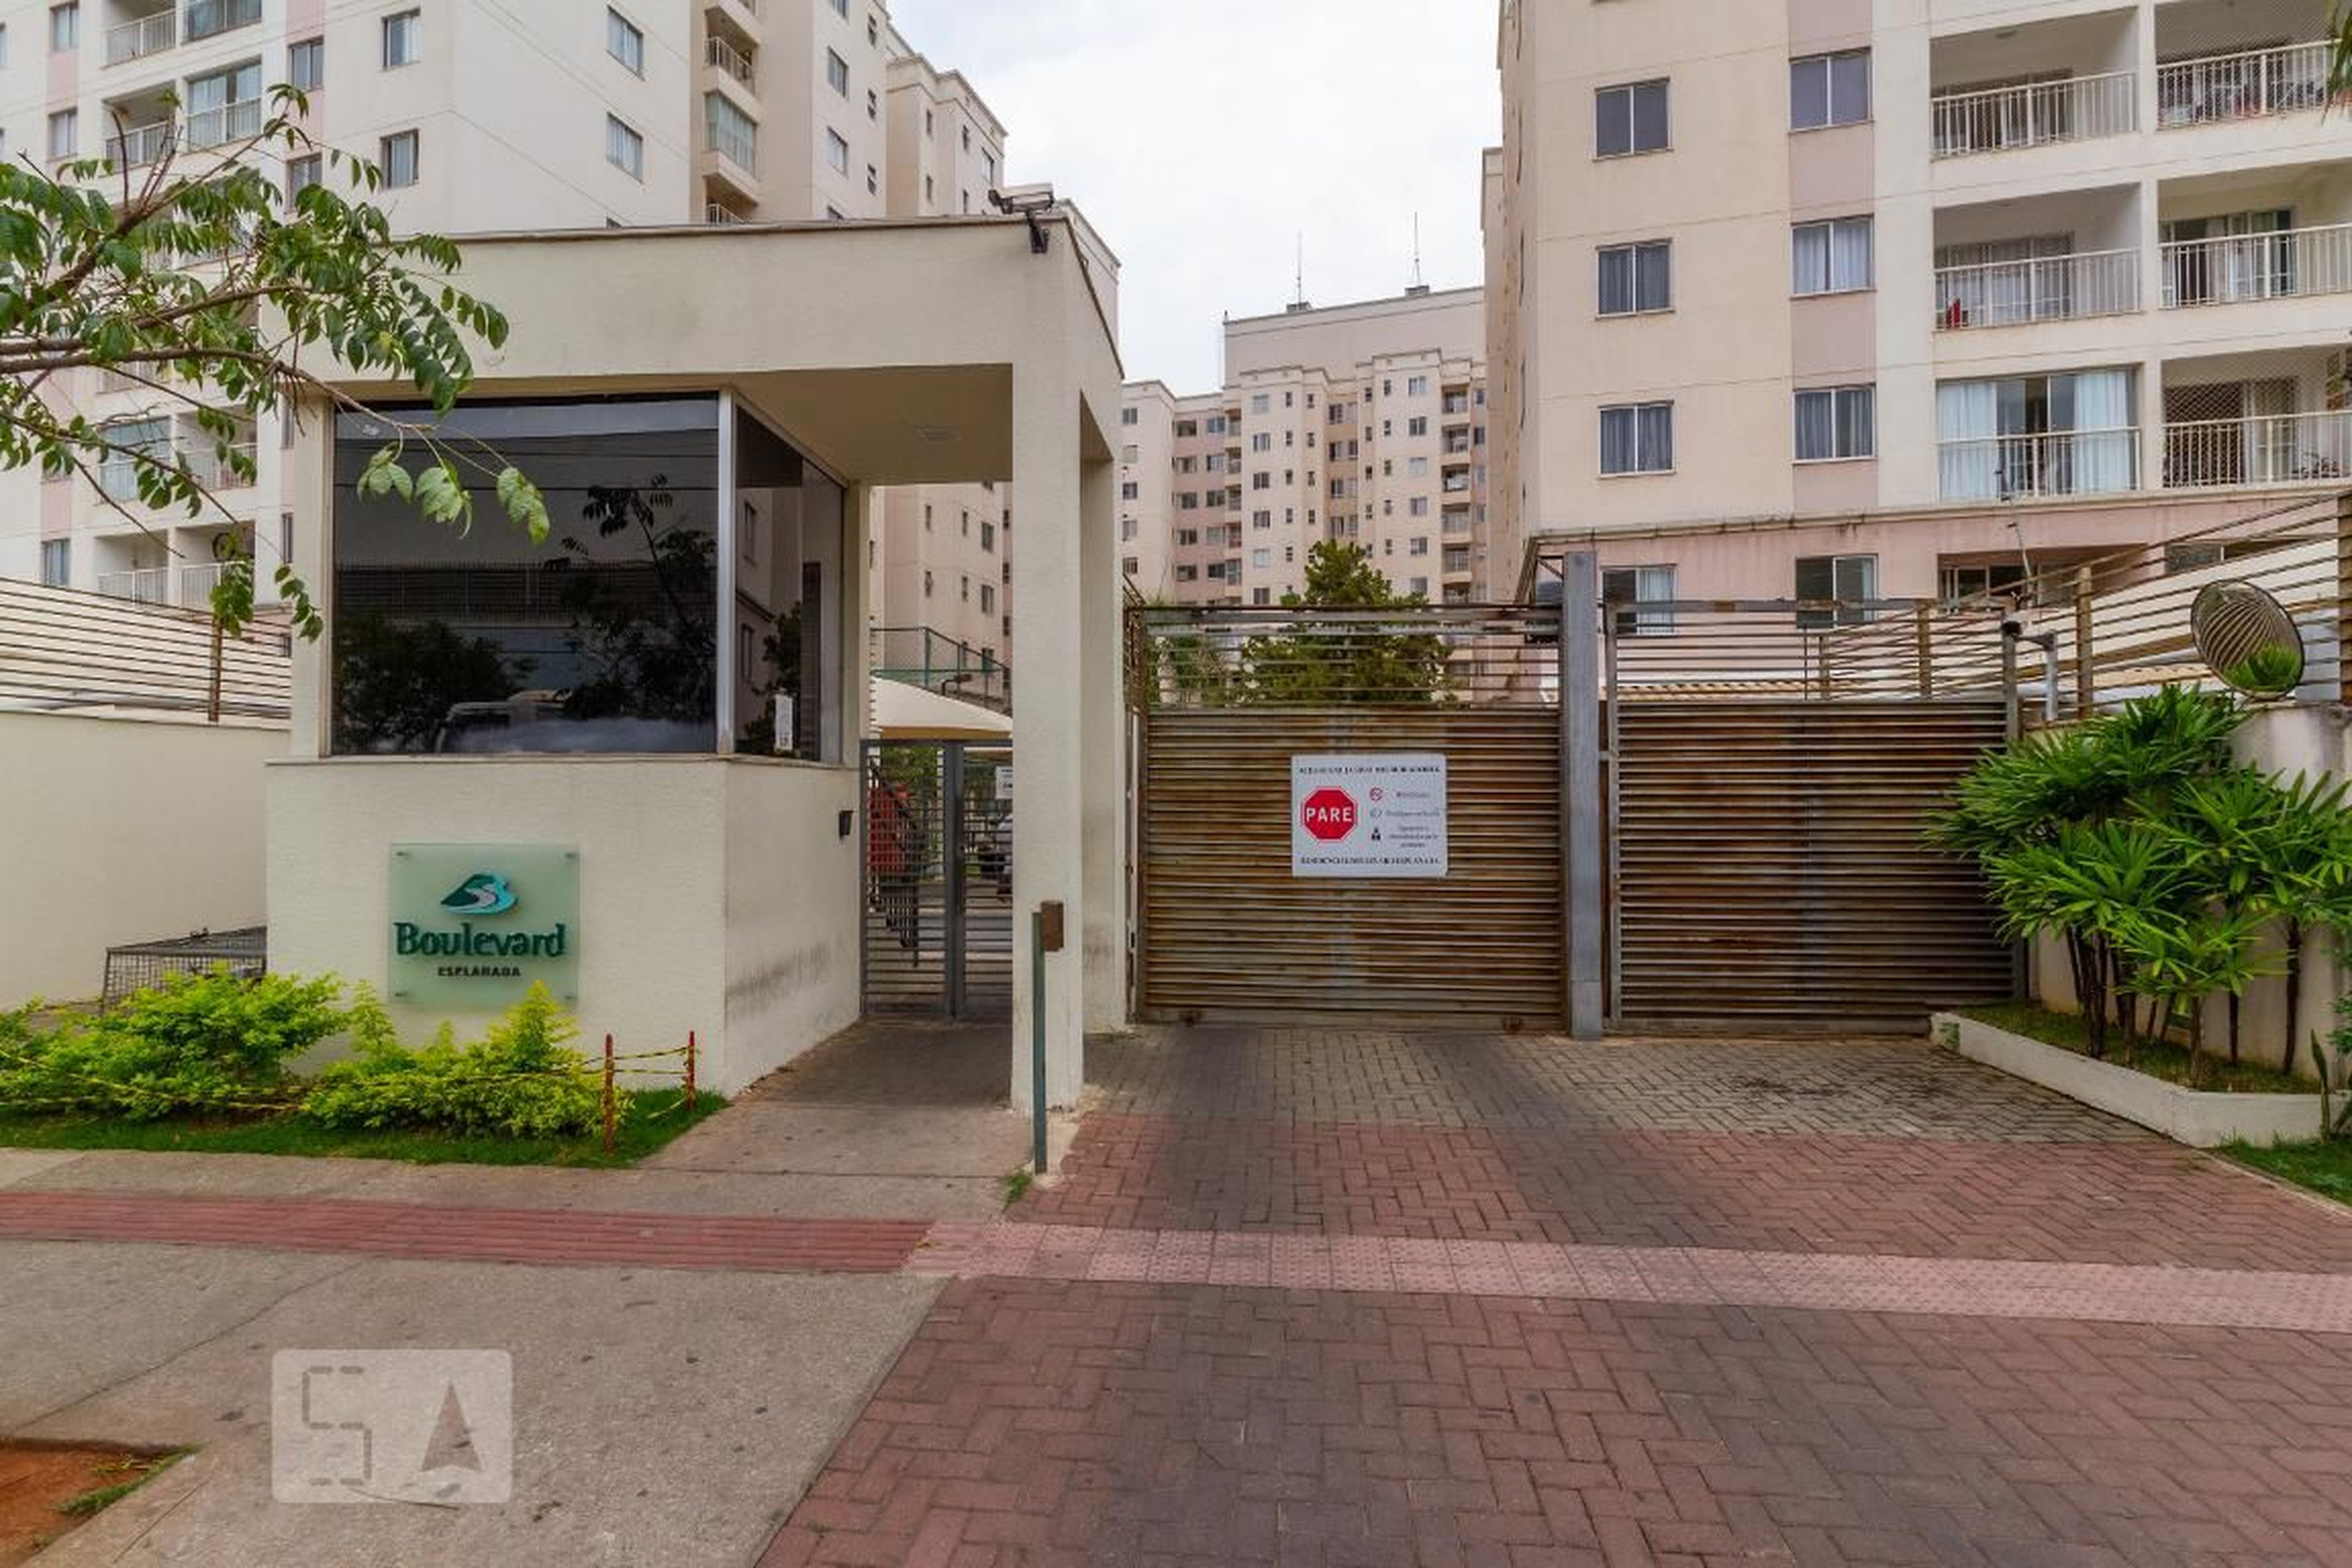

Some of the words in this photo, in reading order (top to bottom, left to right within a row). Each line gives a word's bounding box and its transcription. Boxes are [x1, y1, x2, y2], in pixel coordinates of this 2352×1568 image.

[1306, 807, 1352, 822] PARE
[393, 922, 565, 957] Boulevard
[438, 966, 521, 977] ESPLANADA
